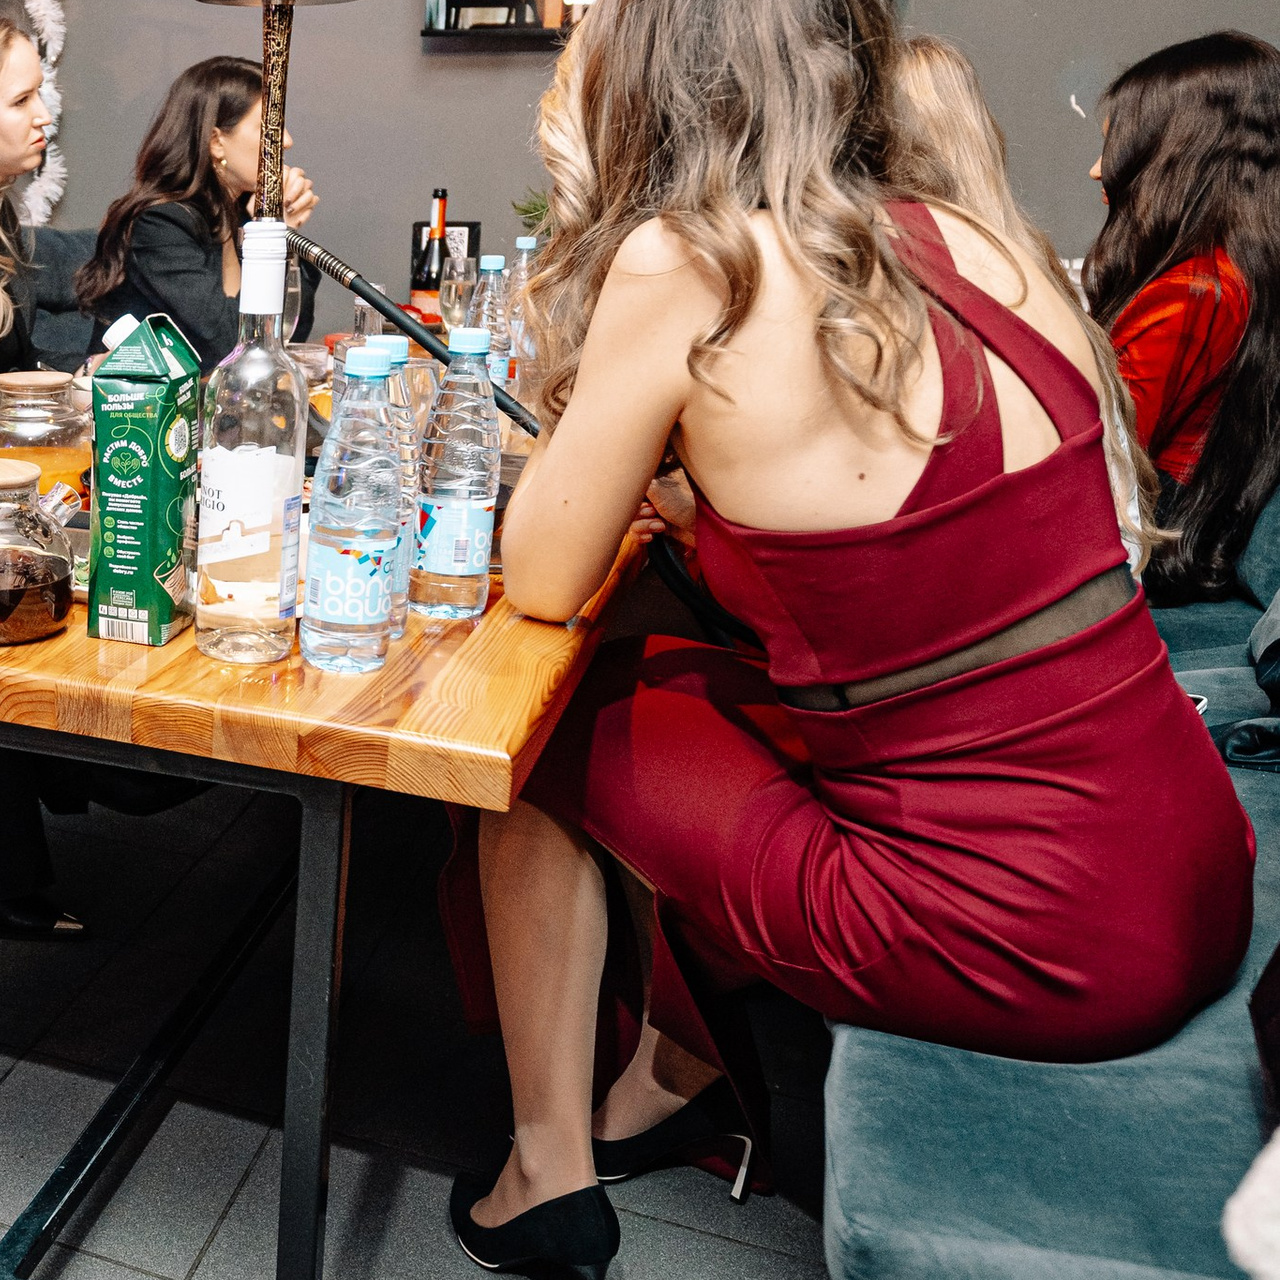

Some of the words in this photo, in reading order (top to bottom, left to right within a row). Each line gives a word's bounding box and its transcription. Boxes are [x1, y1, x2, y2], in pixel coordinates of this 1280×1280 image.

[107, 392, 145, 402] БОЛЬШЕ
[101, 402, 134, 411] ПОЛЬЗЫ
[102, 440, 128, 463] РАСТИМ
[128, 441, 148, 467] ДОБРО
[108, 474, 144, 488] ВМЕСТЕ
[200, 496, 225, 512] IGIO
